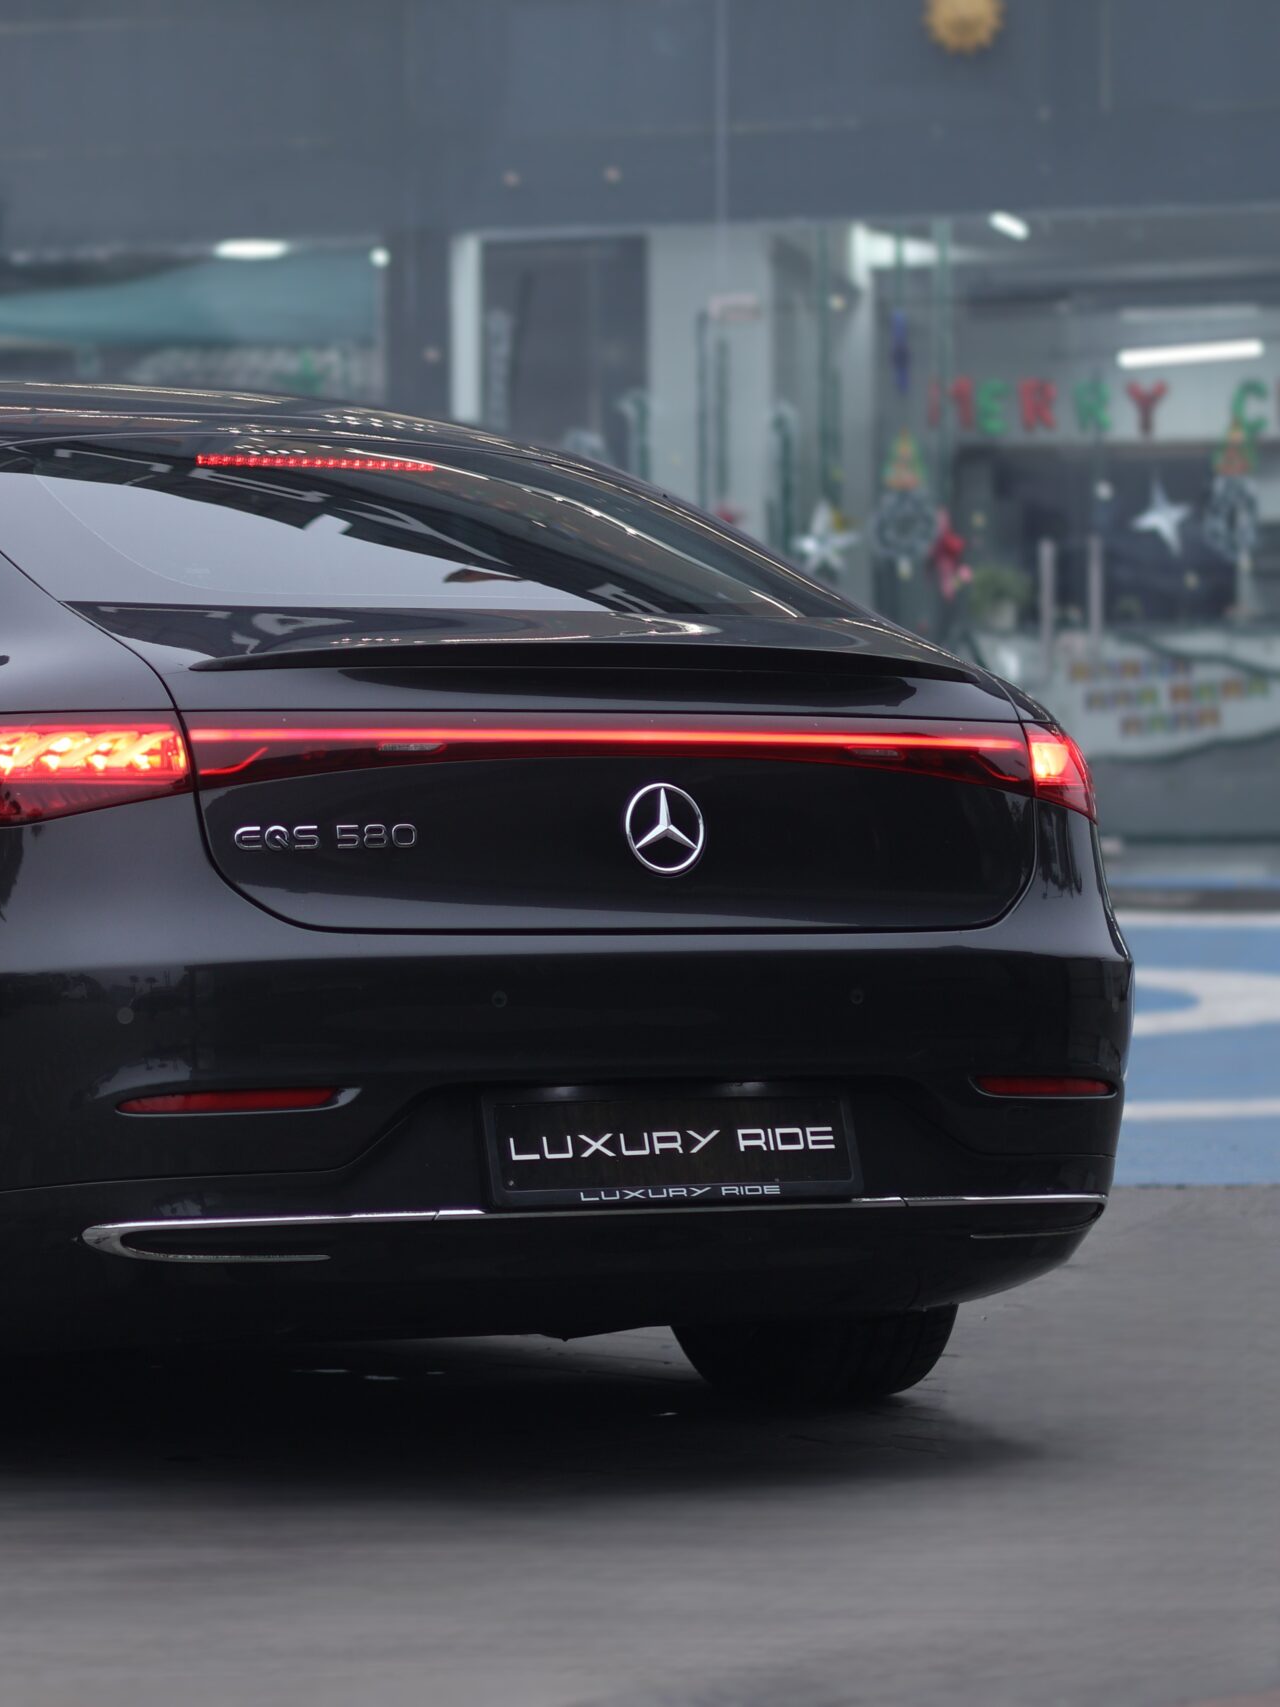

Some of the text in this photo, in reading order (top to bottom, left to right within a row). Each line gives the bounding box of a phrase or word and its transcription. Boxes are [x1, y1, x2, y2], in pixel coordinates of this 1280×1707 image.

[234, 823, 418, 850] EQS 580
[509, 1126, 835, 1161] LUXURY RIDE
[580, 1185, 781, 1201] LUXURY RIDE
